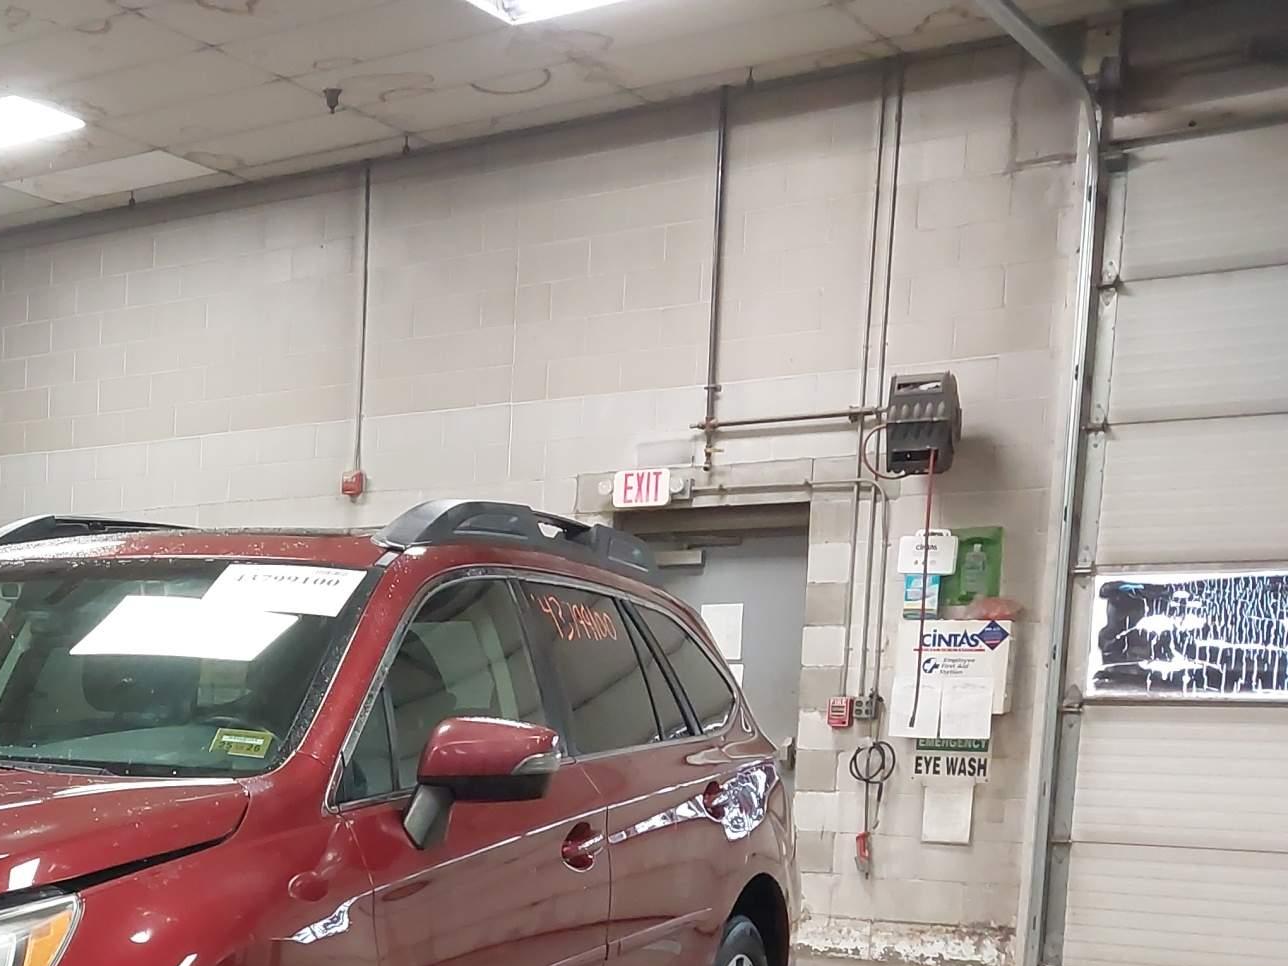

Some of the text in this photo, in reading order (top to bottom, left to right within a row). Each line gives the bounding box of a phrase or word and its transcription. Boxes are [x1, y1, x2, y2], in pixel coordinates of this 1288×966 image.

[623, 471, 663, 504] EXIT
[914, 756, 988, 777] EYE WASH
